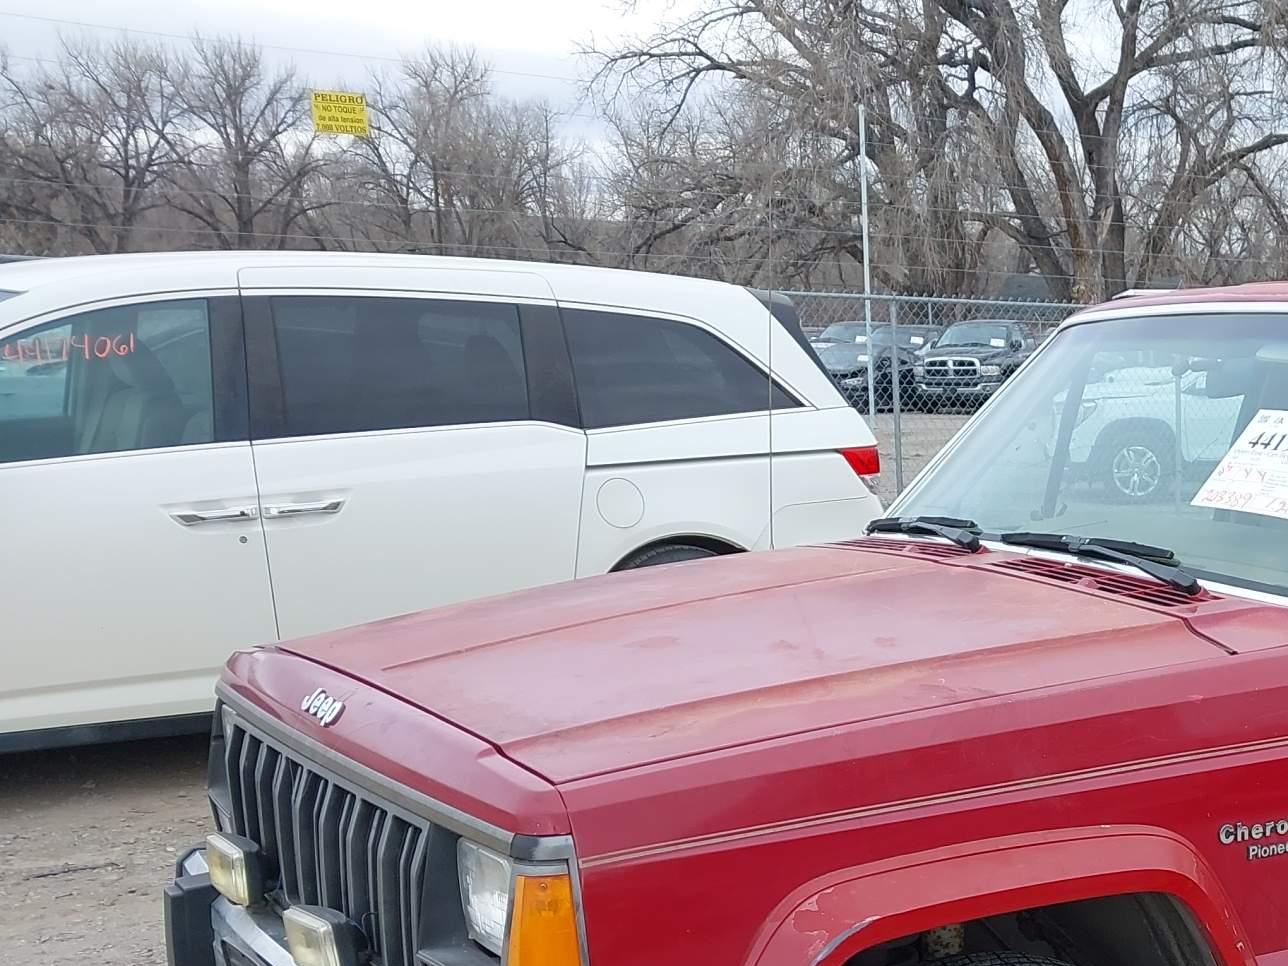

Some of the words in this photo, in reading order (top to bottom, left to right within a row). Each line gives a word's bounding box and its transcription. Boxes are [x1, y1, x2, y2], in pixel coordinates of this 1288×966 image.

[314, 93, 363, 104] PELIGRO
[321, 104, 332, 112] NO
[333, 106, 357, 114] TOQUE
[335, 124, 367, 133] VOLTIOS
[301, 688, 343, 726] Jeep
